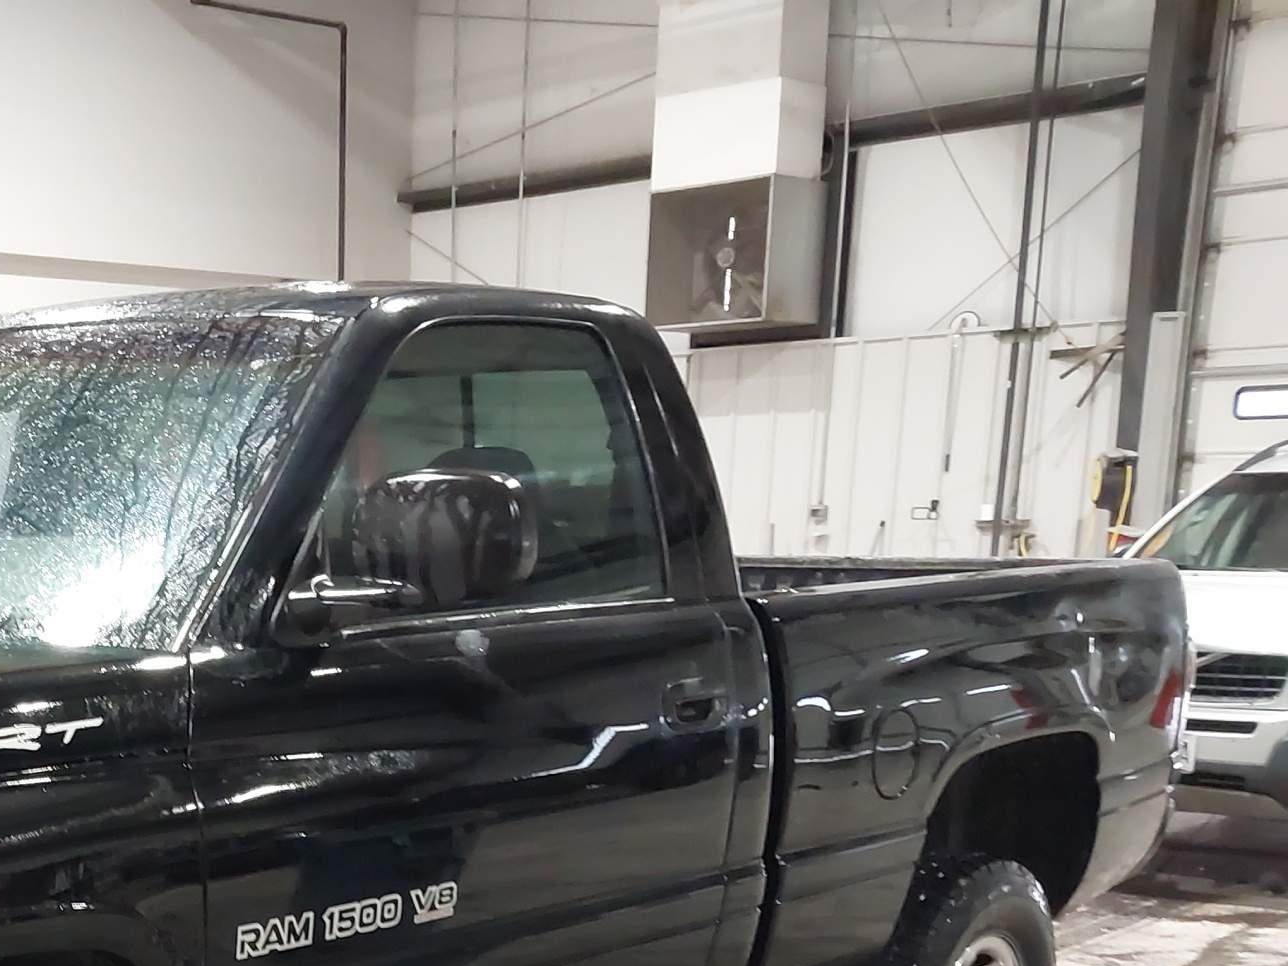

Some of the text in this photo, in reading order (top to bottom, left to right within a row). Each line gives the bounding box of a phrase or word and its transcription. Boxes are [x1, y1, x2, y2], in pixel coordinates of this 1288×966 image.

[235, 881, 457, 961] RAM 1500 V8
